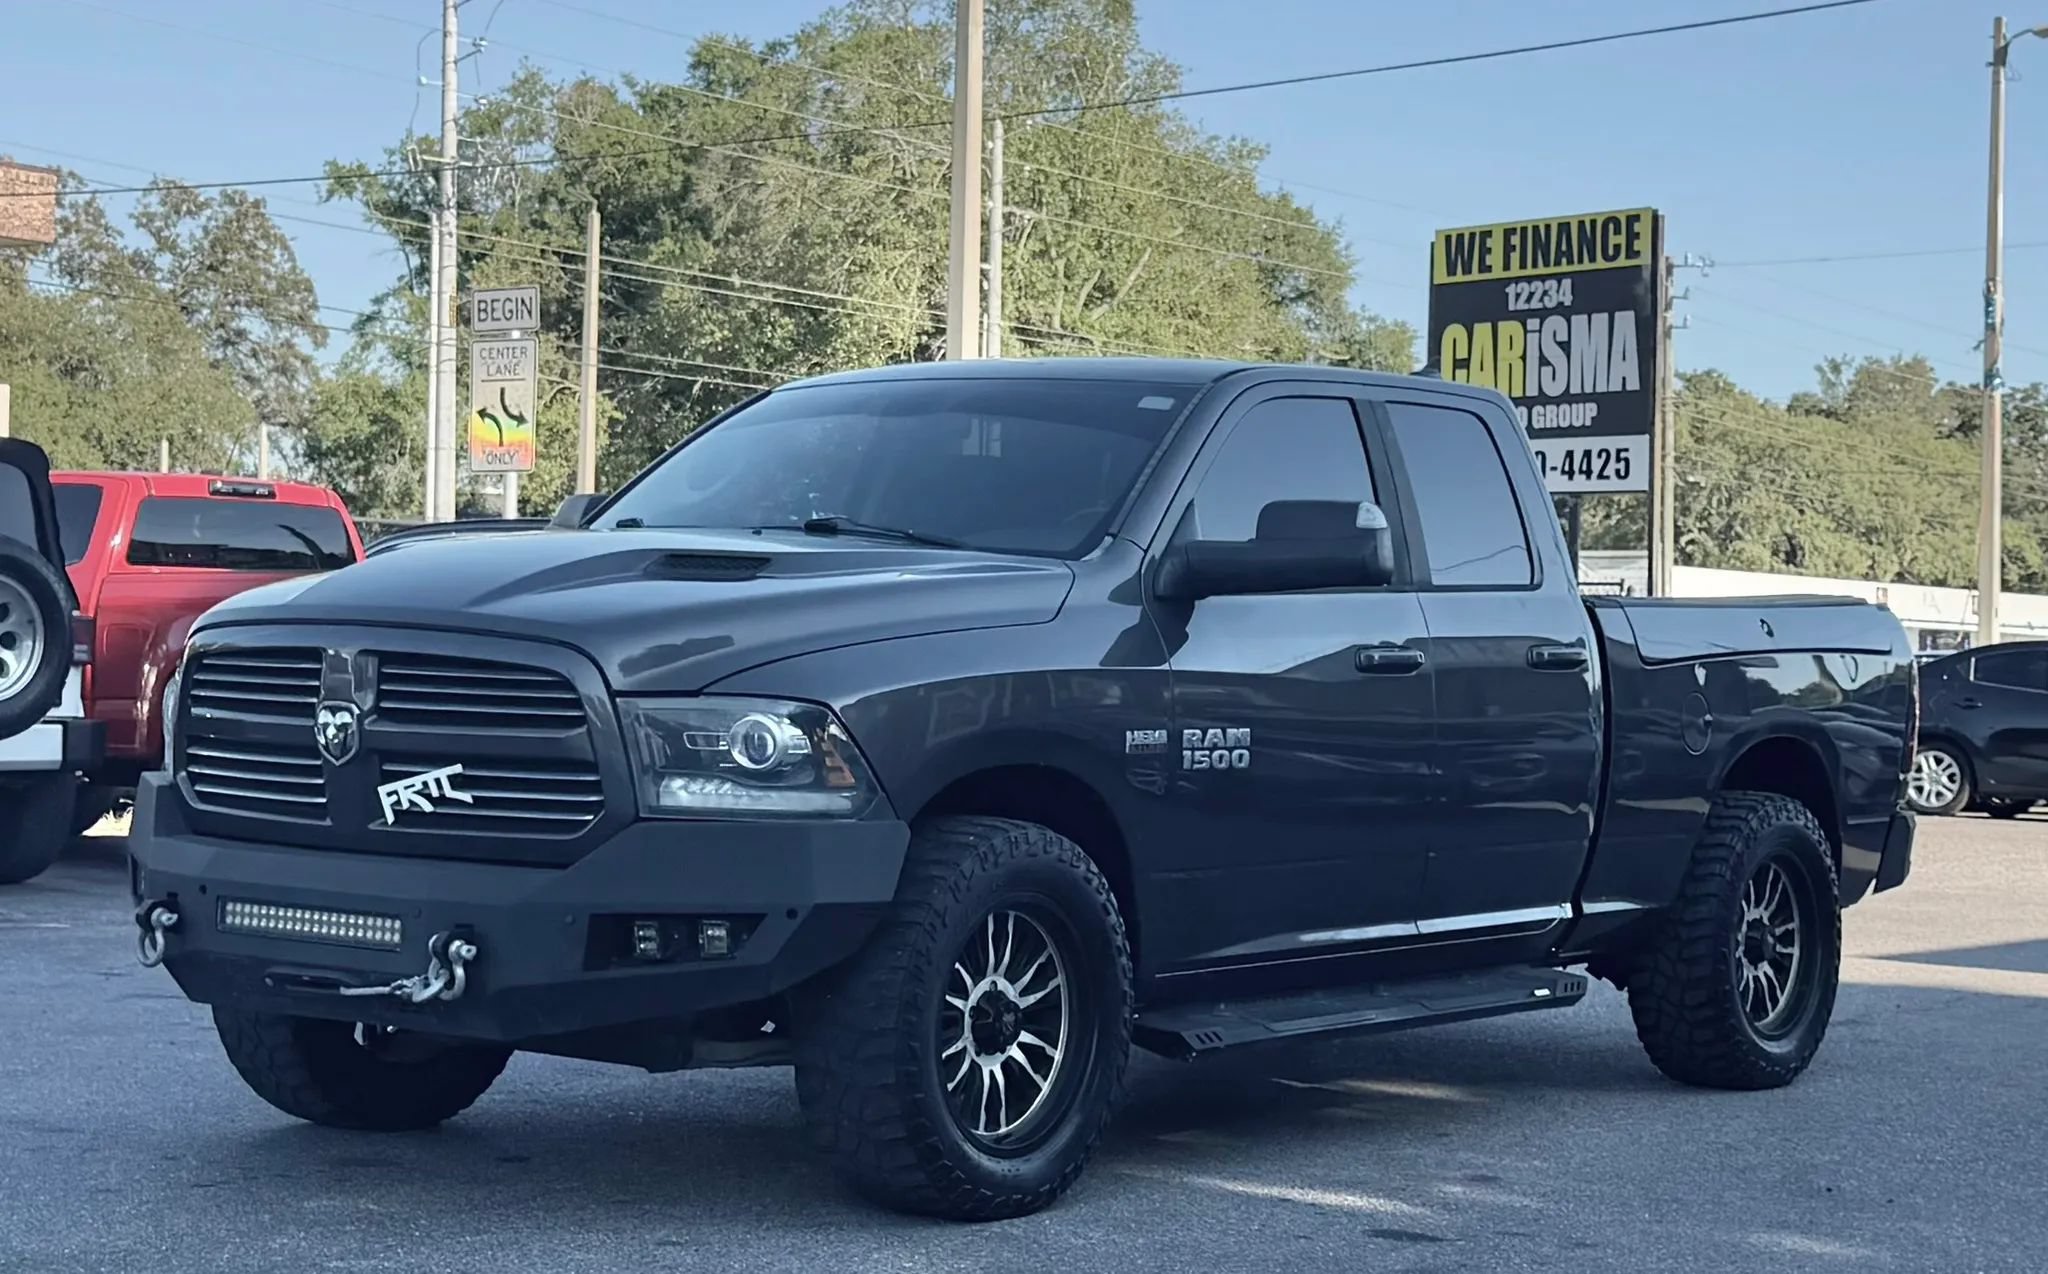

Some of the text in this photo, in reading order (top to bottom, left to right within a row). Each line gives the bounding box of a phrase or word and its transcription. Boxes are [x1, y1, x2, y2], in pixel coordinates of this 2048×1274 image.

[1444, 214, 1641, 277] WE FINANCE
[1505, 278, 1573, 311] 12234
[477, 296, 533, 322] BEGIN
[479, 346, 528, 360] CENTER
[486, 362, 520, 377] LANE
[1531, 402, 1598, 429] GROUP
[486, 451, 517, 466] ONLY
[1182, 728, 1251, 749] RAM
[1182, 749, 1251, 770] 1500
